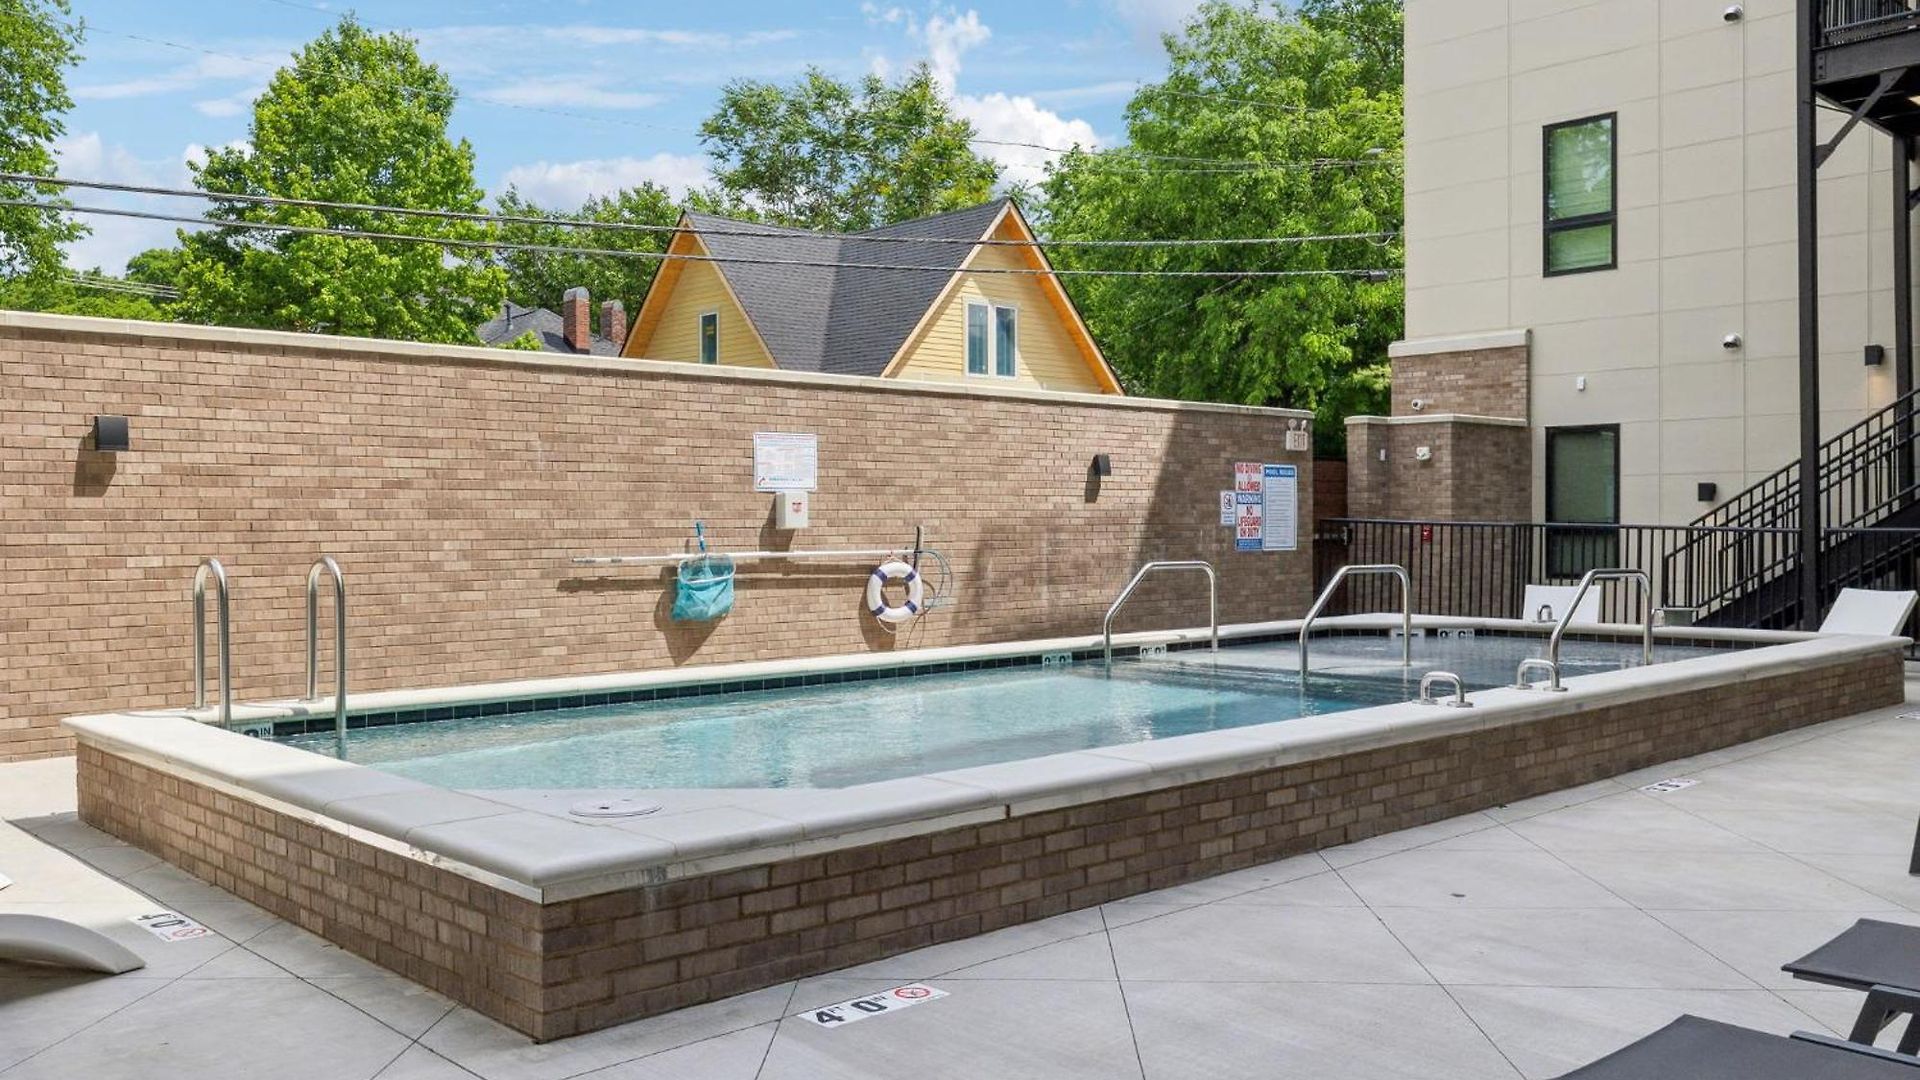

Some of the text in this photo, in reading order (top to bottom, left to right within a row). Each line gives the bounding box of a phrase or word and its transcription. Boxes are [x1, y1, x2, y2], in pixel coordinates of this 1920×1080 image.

[1293, 433, 1306, 449] EXIT
[1236, 464, 1262, 474] NO DIVING
[1238, 481, 1261, 491] ALLOWED
[1237, 494, 1262, 503] WARNING
[1246, 505, 1253, 516] NO
[1238, 516, 1262, 527] LIFEGUARD
[1240, 527, 1260, 537] ON DUTY
[260, 727, 271, 735] IN
[815, 1010, 846, 1024] 4
